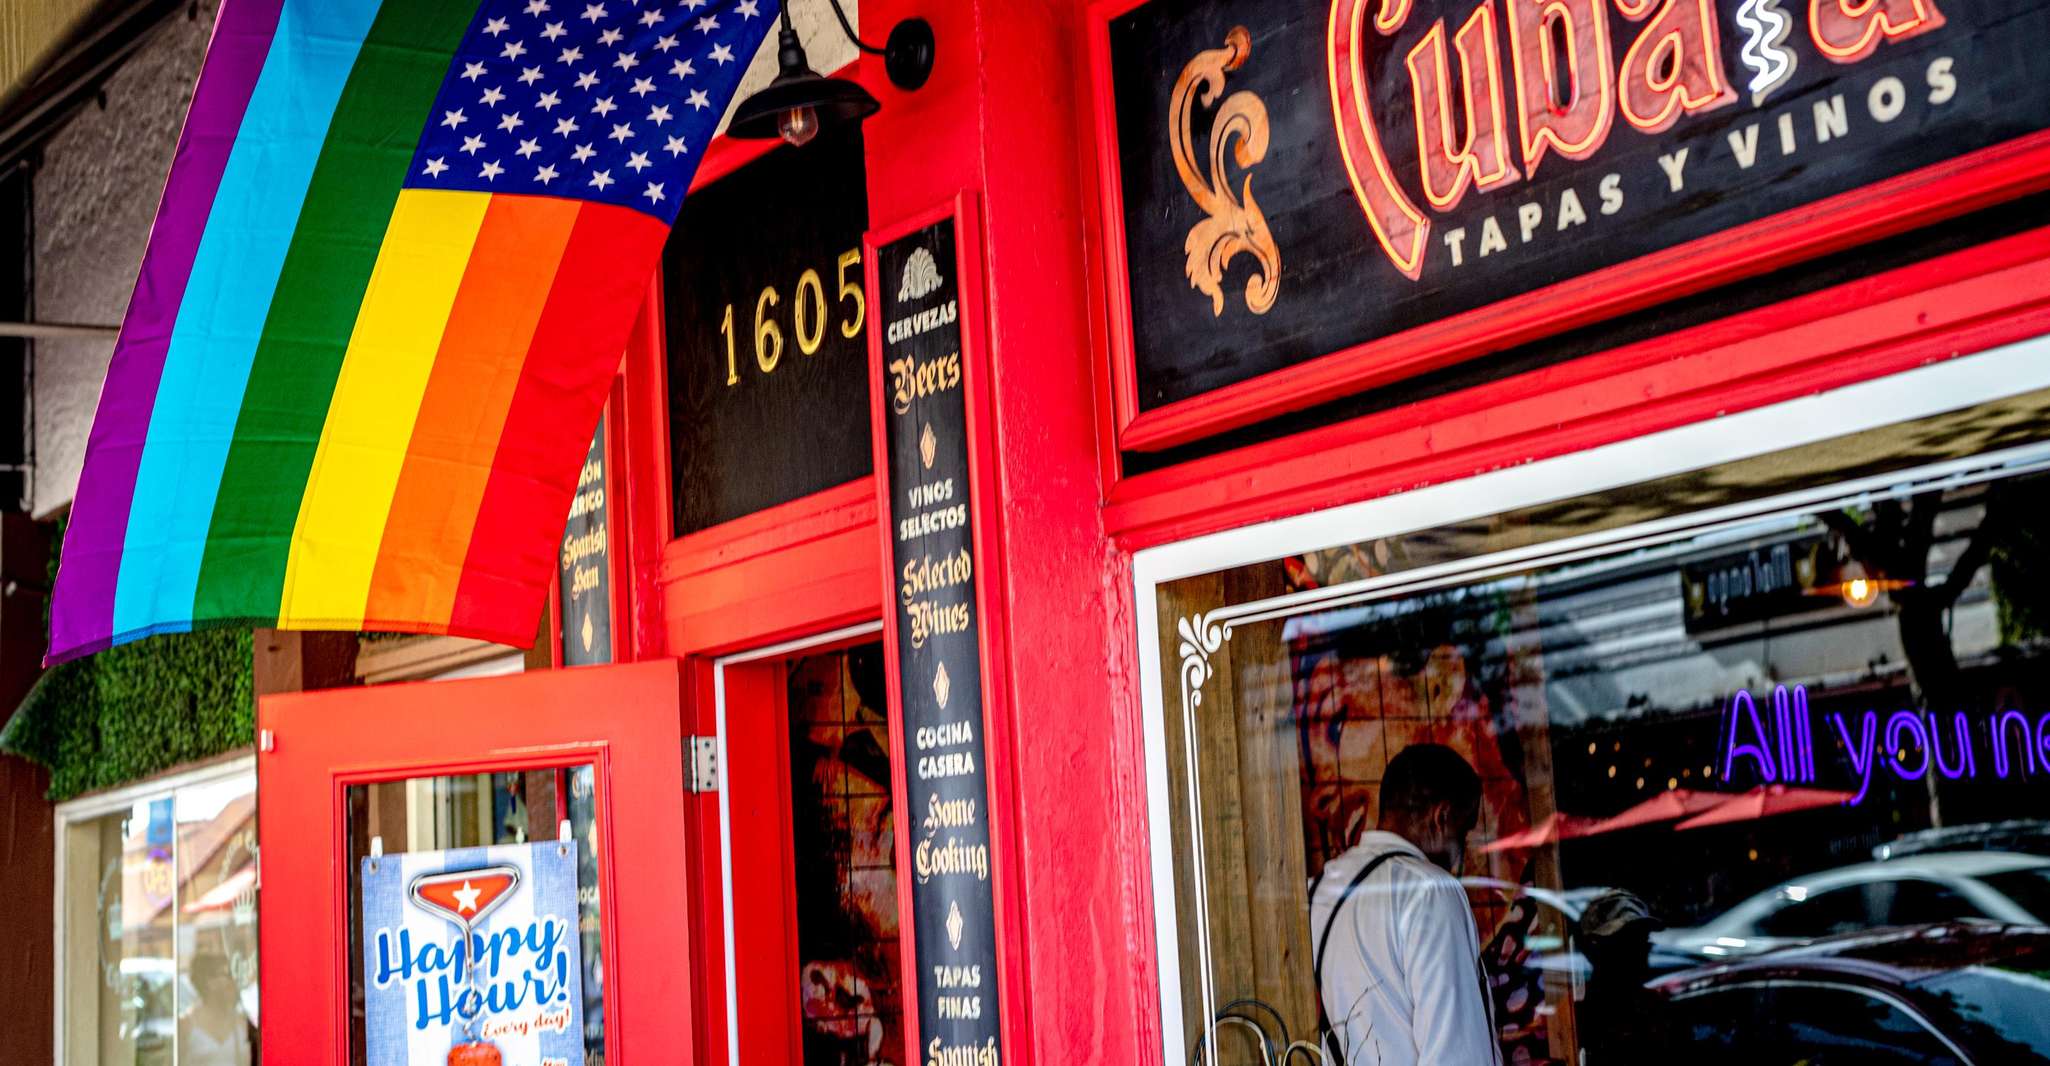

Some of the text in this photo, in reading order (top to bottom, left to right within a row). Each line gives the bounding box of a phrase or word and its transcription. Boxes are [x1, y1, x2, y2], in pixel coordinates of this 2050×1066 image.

[1444, 56, 1957, 267] TAPAS Y VINOS
[721, 247, 866, 387] 1605
[887, 300, 957, 345] CERVEZAS
[889, 351, 961, 415] Beers
[908, 478, 953, 509] VINOS
[563, 522, 607, 570] Spanish
[900, 503, 966, 541] SELECTOS
[901, 547, 972, 606] Selected
[906, 600, 970, 649] Wines
[916, 720, 973, 750] COCINA
[1723, 683, 1815, 782] All
[1833, 709, 1976, 806] you
[918, 752, 975, 780] CASERA
[923, 792, 976, 838] Home
[915, 836, 988, 885] Cooking
[377, 920, 565, 984] Happy
[415, 951, 567, 1030] Hour!
[934, 964, 981, 989] TAPAS
[483, 1008, 569, 1037] Every day!
[938, 995, 981, 1020] FINAS
